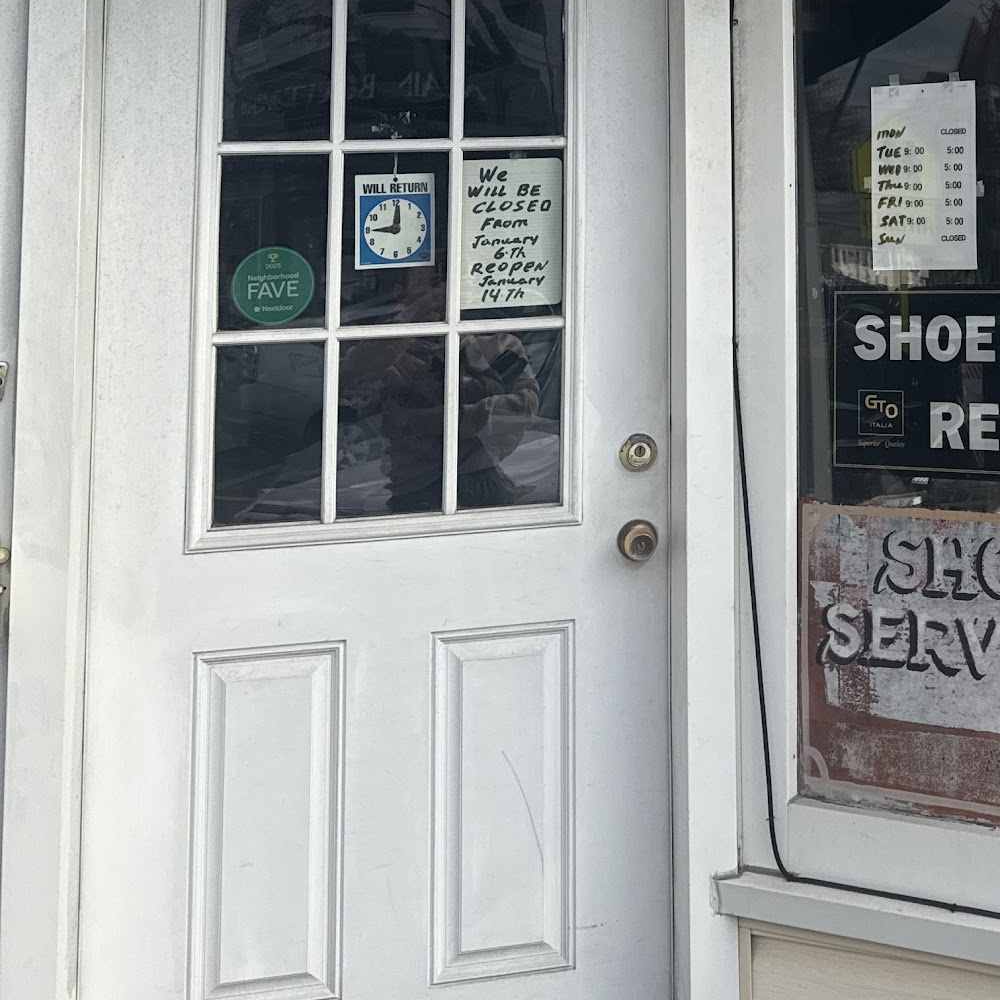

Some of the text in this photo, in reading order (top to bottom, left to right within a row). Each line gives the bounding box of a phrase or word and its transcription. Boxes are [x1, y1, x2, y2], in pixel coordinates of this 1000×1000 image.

[940, 127, 967, 135] CLOSED
[876, 145, 902, 159] TUE
[947, 146, 964, 154] 5:00
[479, 165, 508, 183] We
[878, 164, 902, 176] WED
[363, 182, 428, 194] WILL RETURN
[945, 180, 962, 189] 5:00
[467, 183, 542, 198] WILL BE
[379, 203, 387, 211] 11
[472, 199, 552, 214] CLOSED
[877, 196, 903, 209] FRI
[905, 199, 924, 208] 9:00
[369, 213, 378, 222] 10
[416, 211, 422, 219] 2
[879, 214, 907, 227] SAT
[365, 226, 371, 234] 9
[420, 224, 426, 232] 3
[369, 238, 375, 246] 8
[416, 236, 422, 244] 4
[471, 234, 539, 249] January
[941, 234, 967, 242] CLOSED
[393, 250, 399, 258] 6
[247, 271, 299, 282] Neighborhood
[478, 275, 546, 288] January
[247, 280, 299, 300] FAVE
[262, 304, 294, 312] Nextdoor
[853, 314, 996, 362] SHOE
[864, 394, 899, 419] GTO
[869, 421, 894, 429] ITALIA
